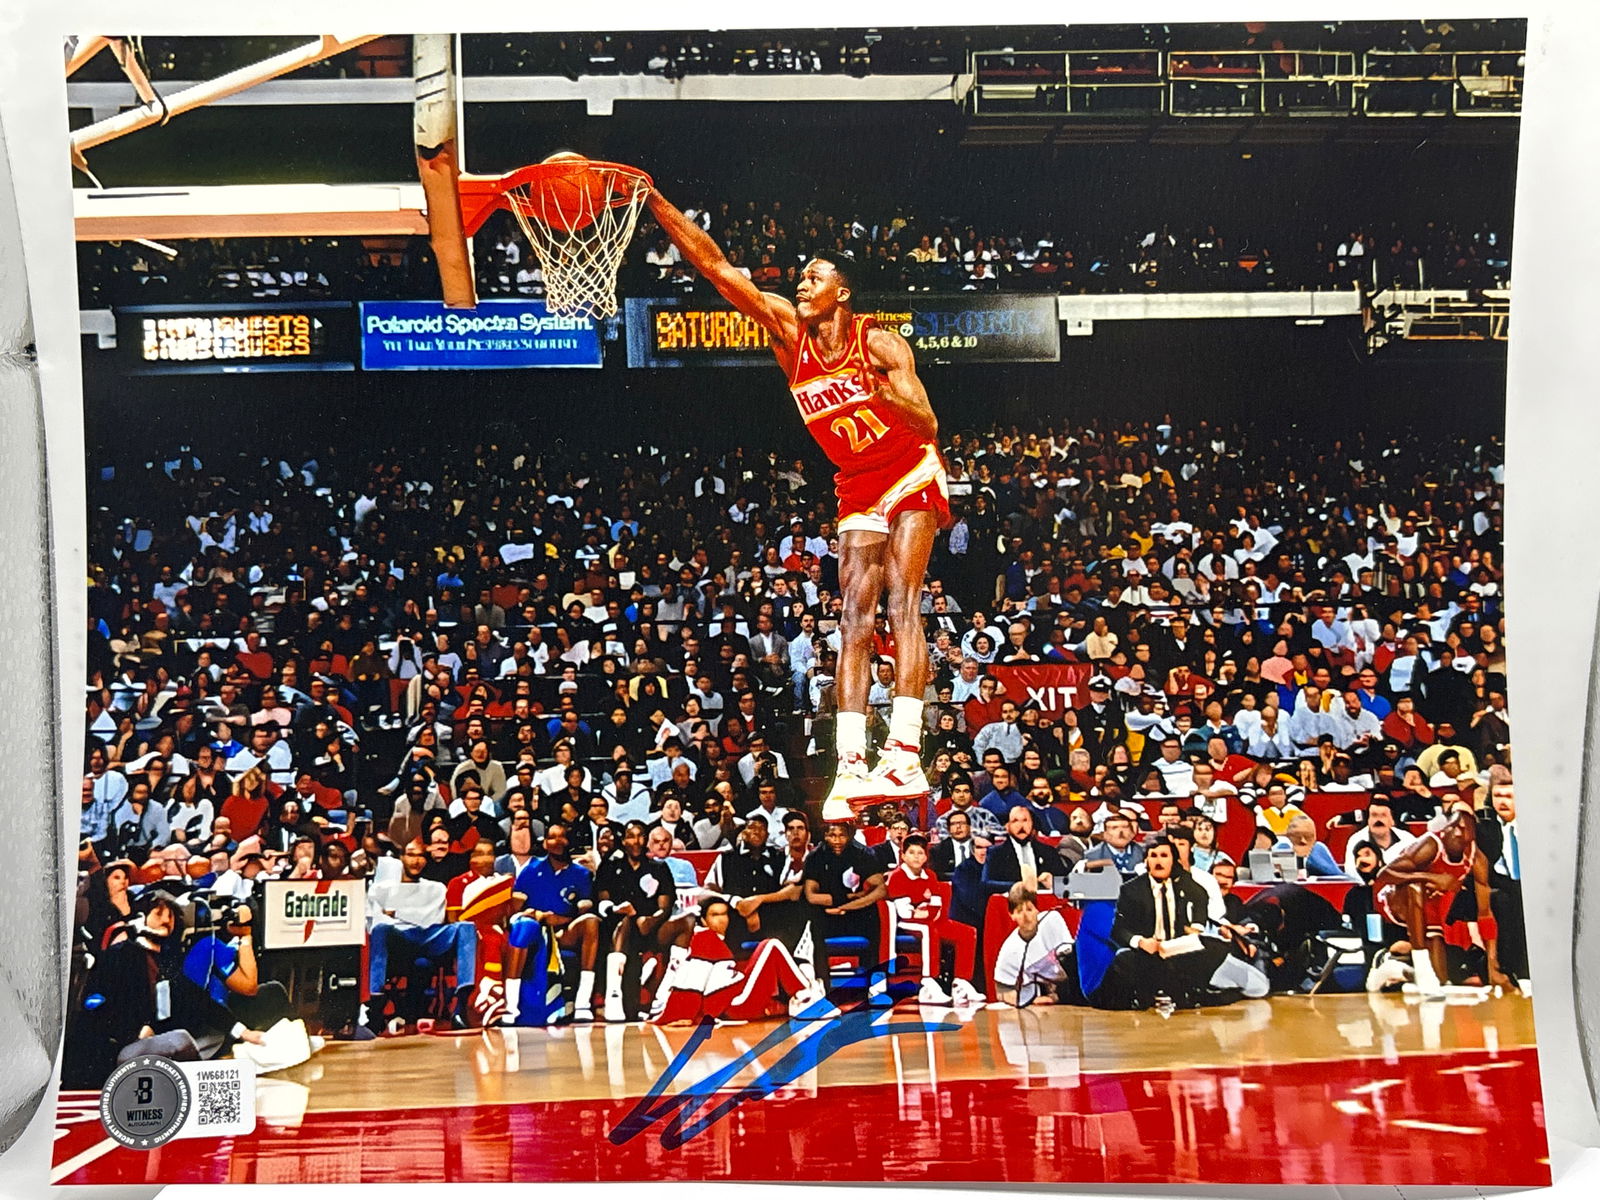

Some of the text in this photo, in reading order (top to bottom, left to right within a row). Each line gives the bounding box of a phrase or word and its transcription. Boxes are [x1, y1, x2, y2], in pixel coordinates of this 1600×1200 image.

[367, 315, 443, 334] Polaroid
[951, 336, 962, 347] &
[964, 336, 978, 347] 10
[797, 374, 865, 416] Hawks
[830, 405, 890, 454] 21
[285, 890, 348, 918] Gatorade
[197, 1069, 240, 1081] 1W668121
[102, 1061, 137, 1145] BECKETT VERIFIED AUTHENTIC
[127, 1109, 163, 1121] WITNESS
[154, 1060, 189, 1144] BECKETT VERIFIED AUTHENTIC
